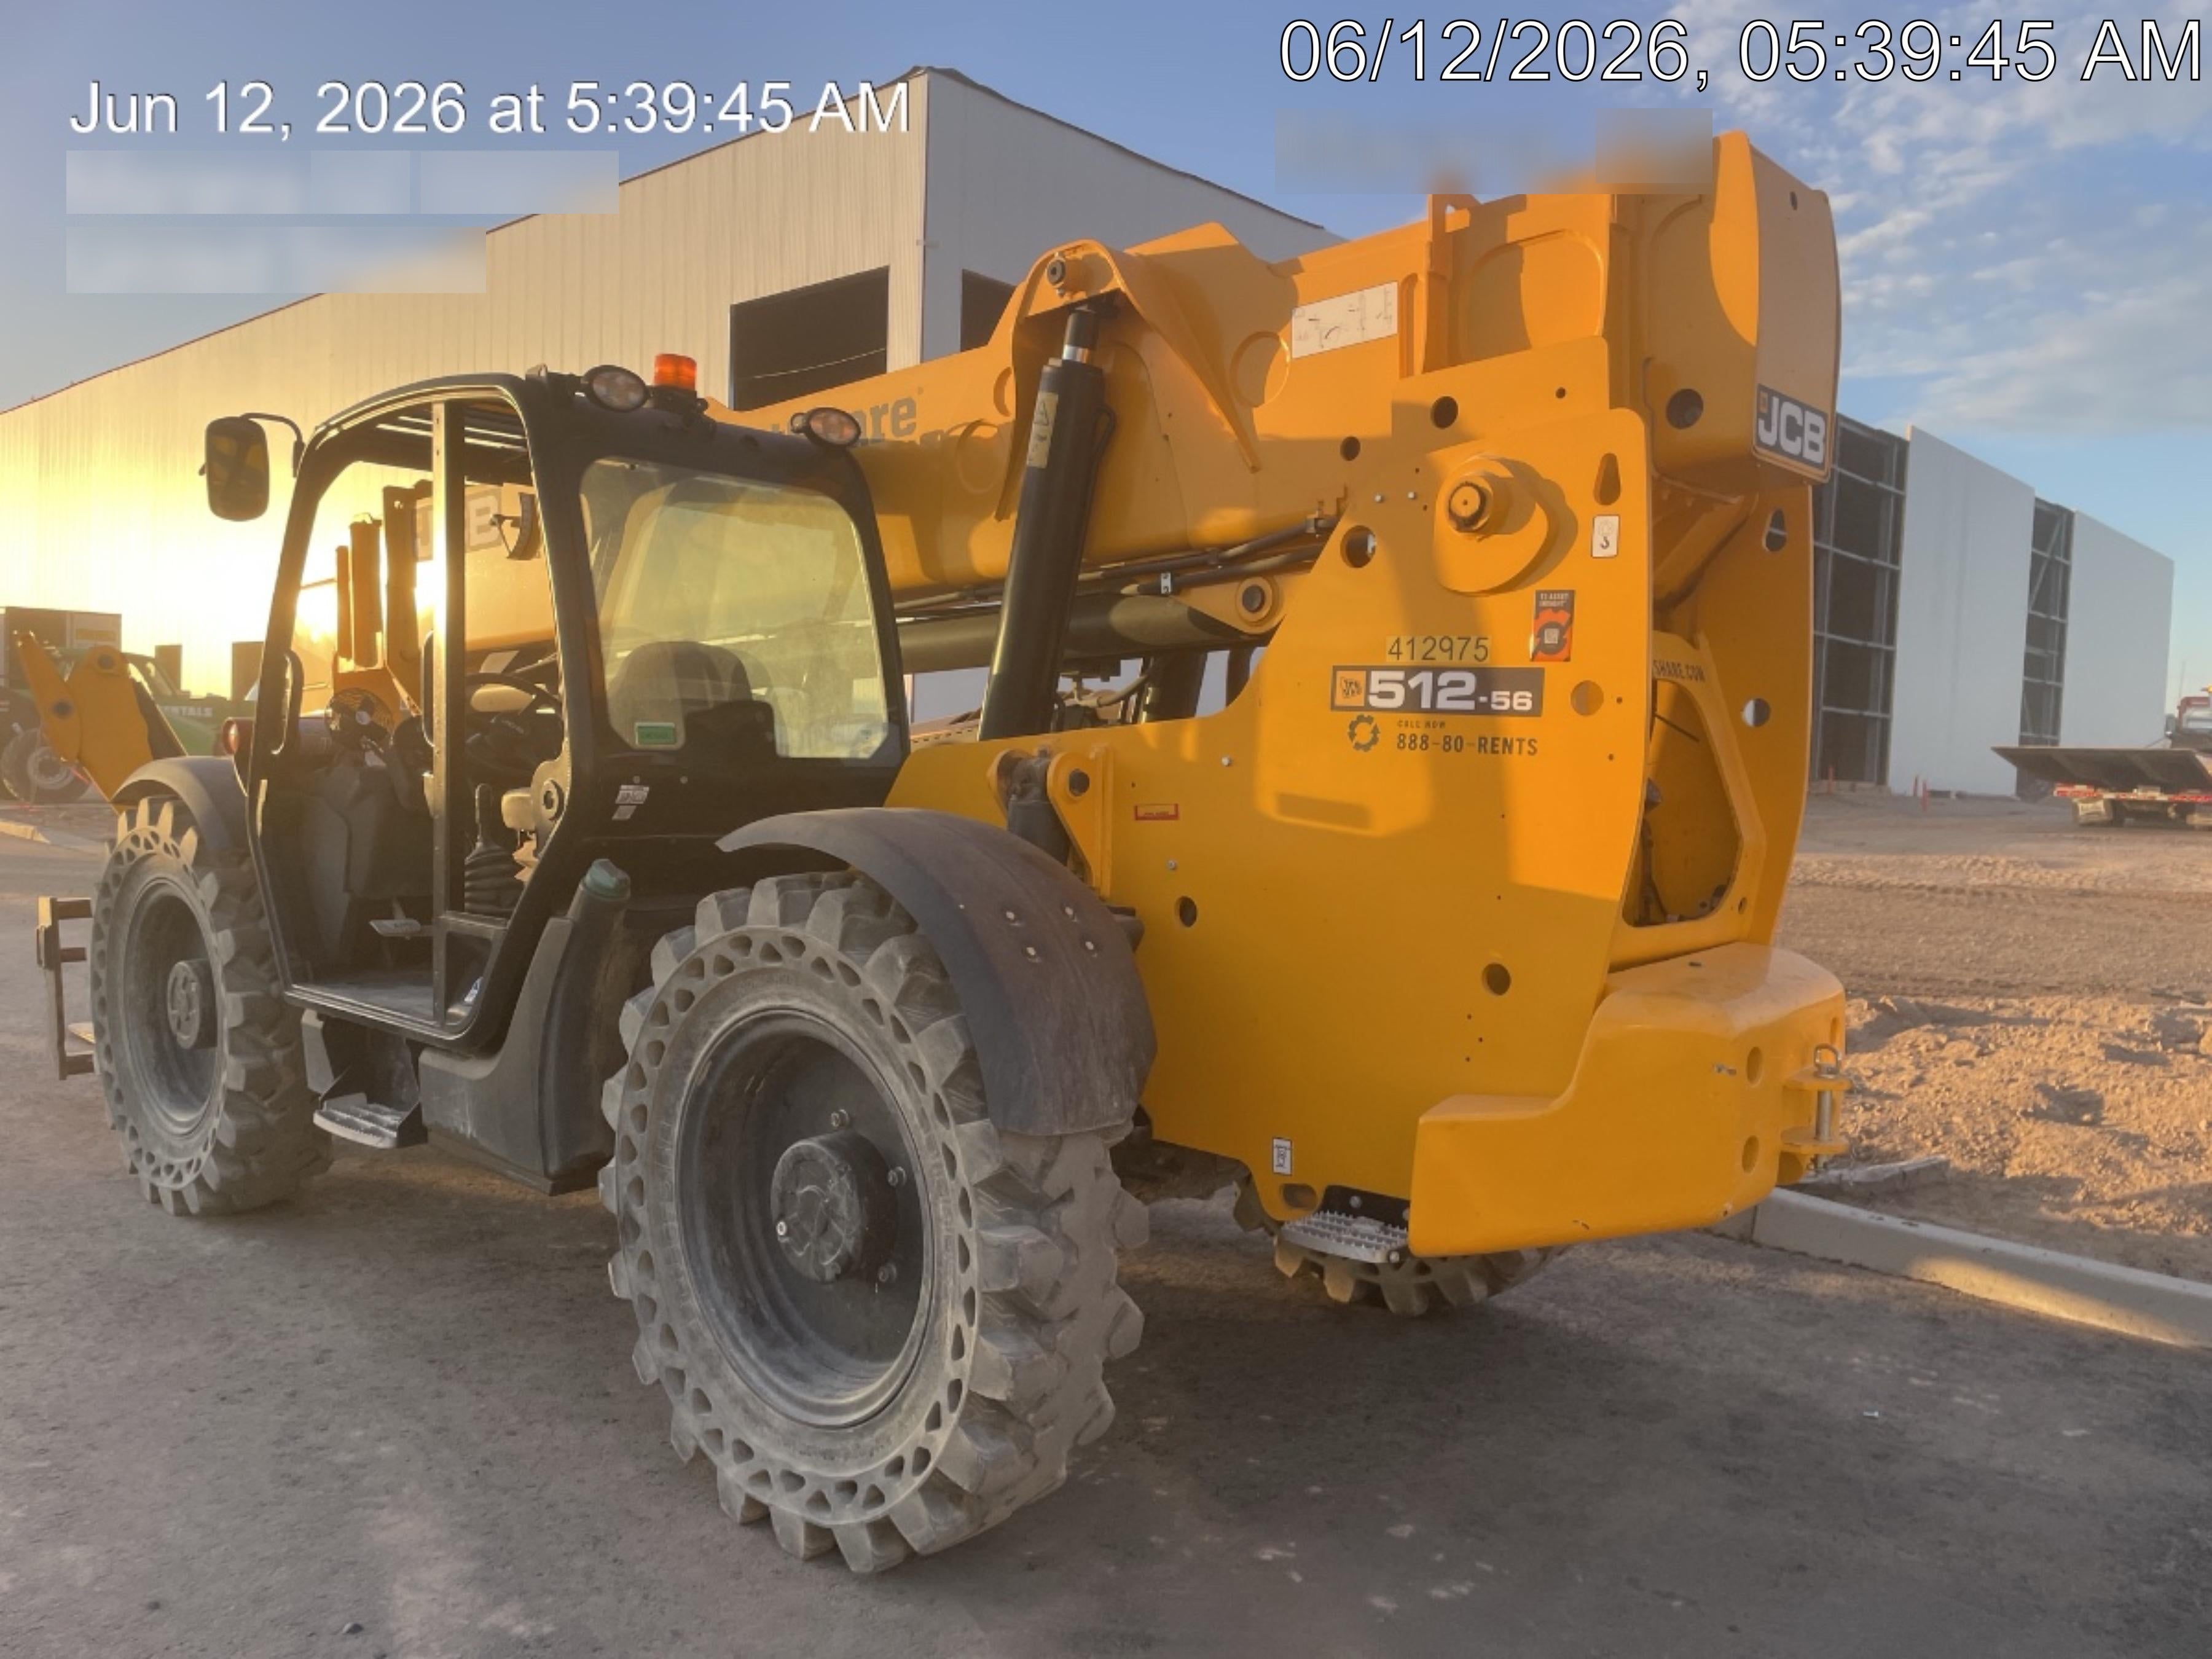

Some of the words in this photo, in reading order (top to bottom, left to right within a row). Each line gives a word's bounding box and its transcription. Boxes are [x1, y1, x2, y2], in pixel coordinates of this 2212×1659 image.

[1758, 396, 1826, 464] JCB
[1388, 635, 1489, 662] 412975
[1368, 670, 1532, 710] 512-56
[1397, 733, 1538, 756] 888-80-RENTS
